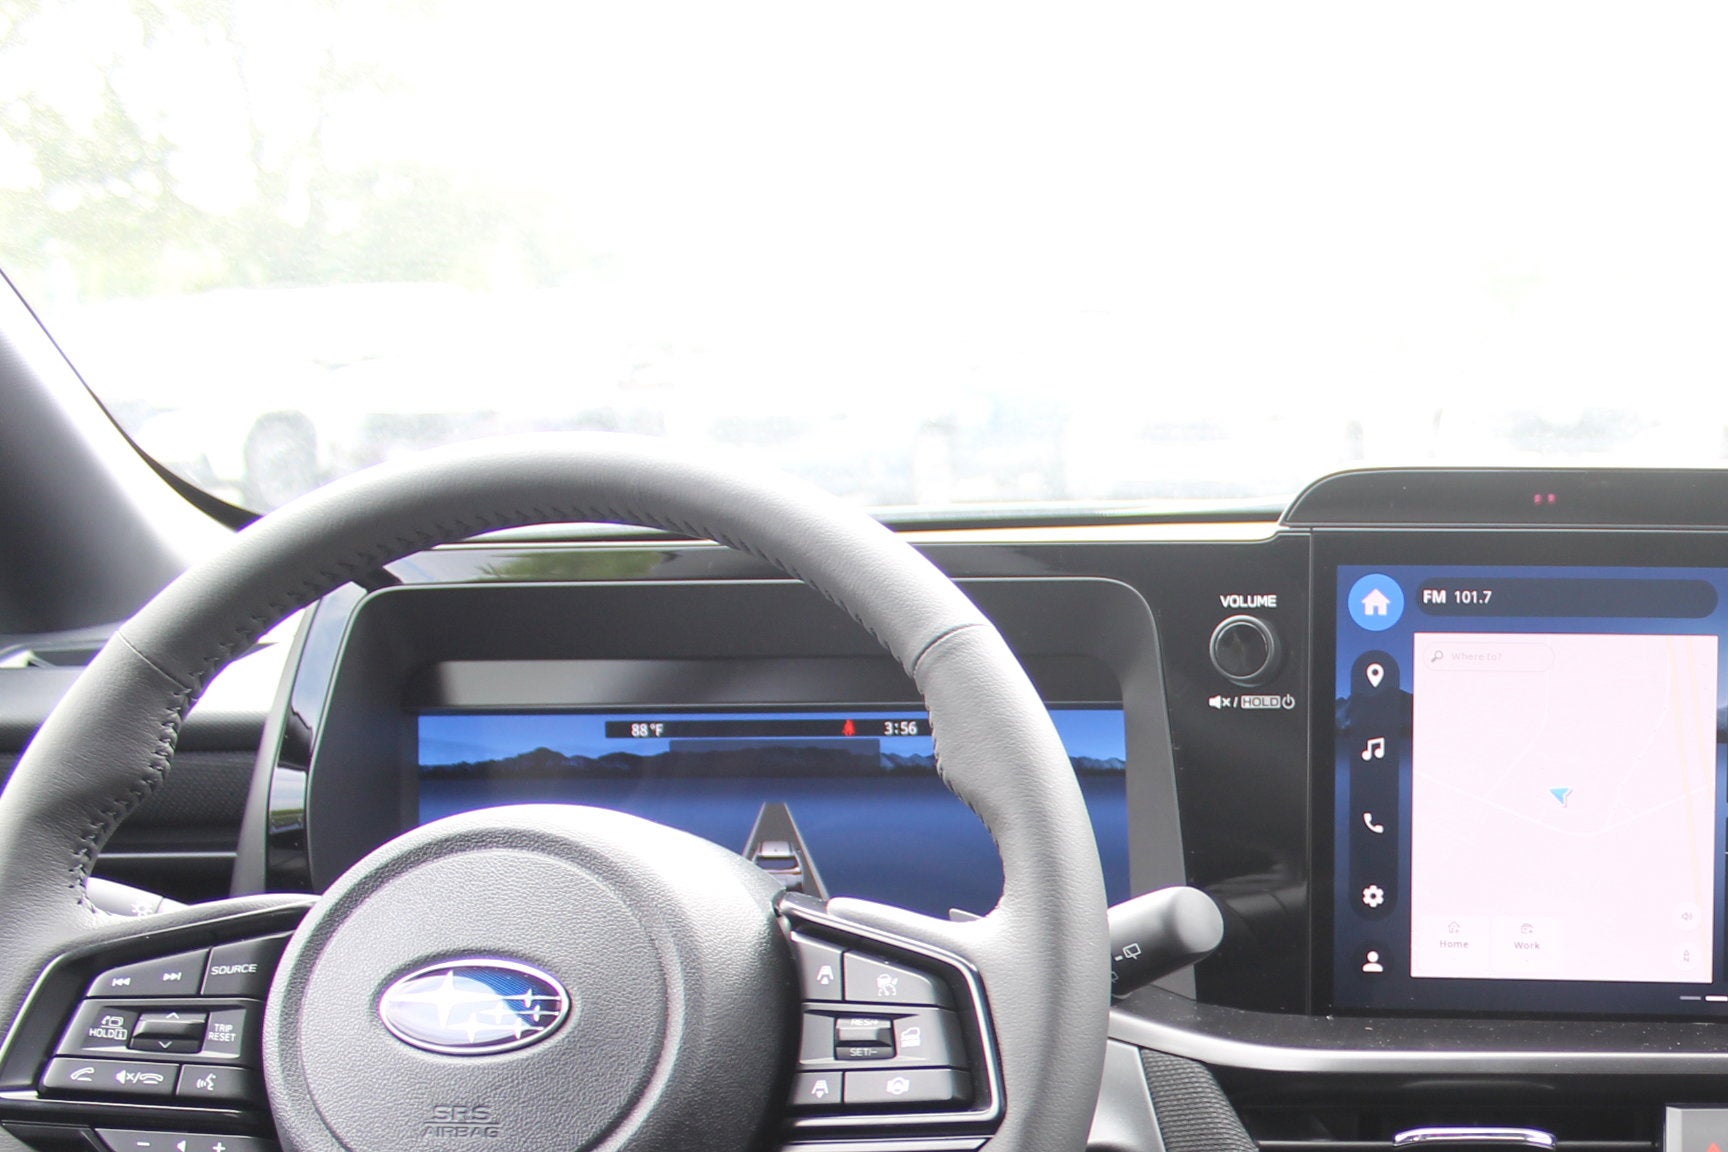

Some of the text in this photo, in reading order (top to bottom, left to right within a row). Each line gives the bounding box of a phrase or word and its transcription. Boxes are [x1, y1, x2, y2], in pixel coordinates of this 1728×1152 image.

[1220, 595, 1277, 608] VOLUME
[1423, 590, 1492, 604] FM 101.7
[1451, 651, 1485, 661] Where
[1242, 696, 1280, 708] HOLD
[884, 721, 917, 735] 3:56
[1440, 940, 1469, 949] Home
[1514, 941, 1540, 950] Work
[211, 963, 257, 976] SOURCE
[89, 1028, 115, 1039] HOLD
[214, 1023, 233, 1033] TRIP
[208, 1032, 237, 1042] RESET
[431, 1104, 492, 1122] SRS
[420, 1125, 501, 1139] AIRBAG
